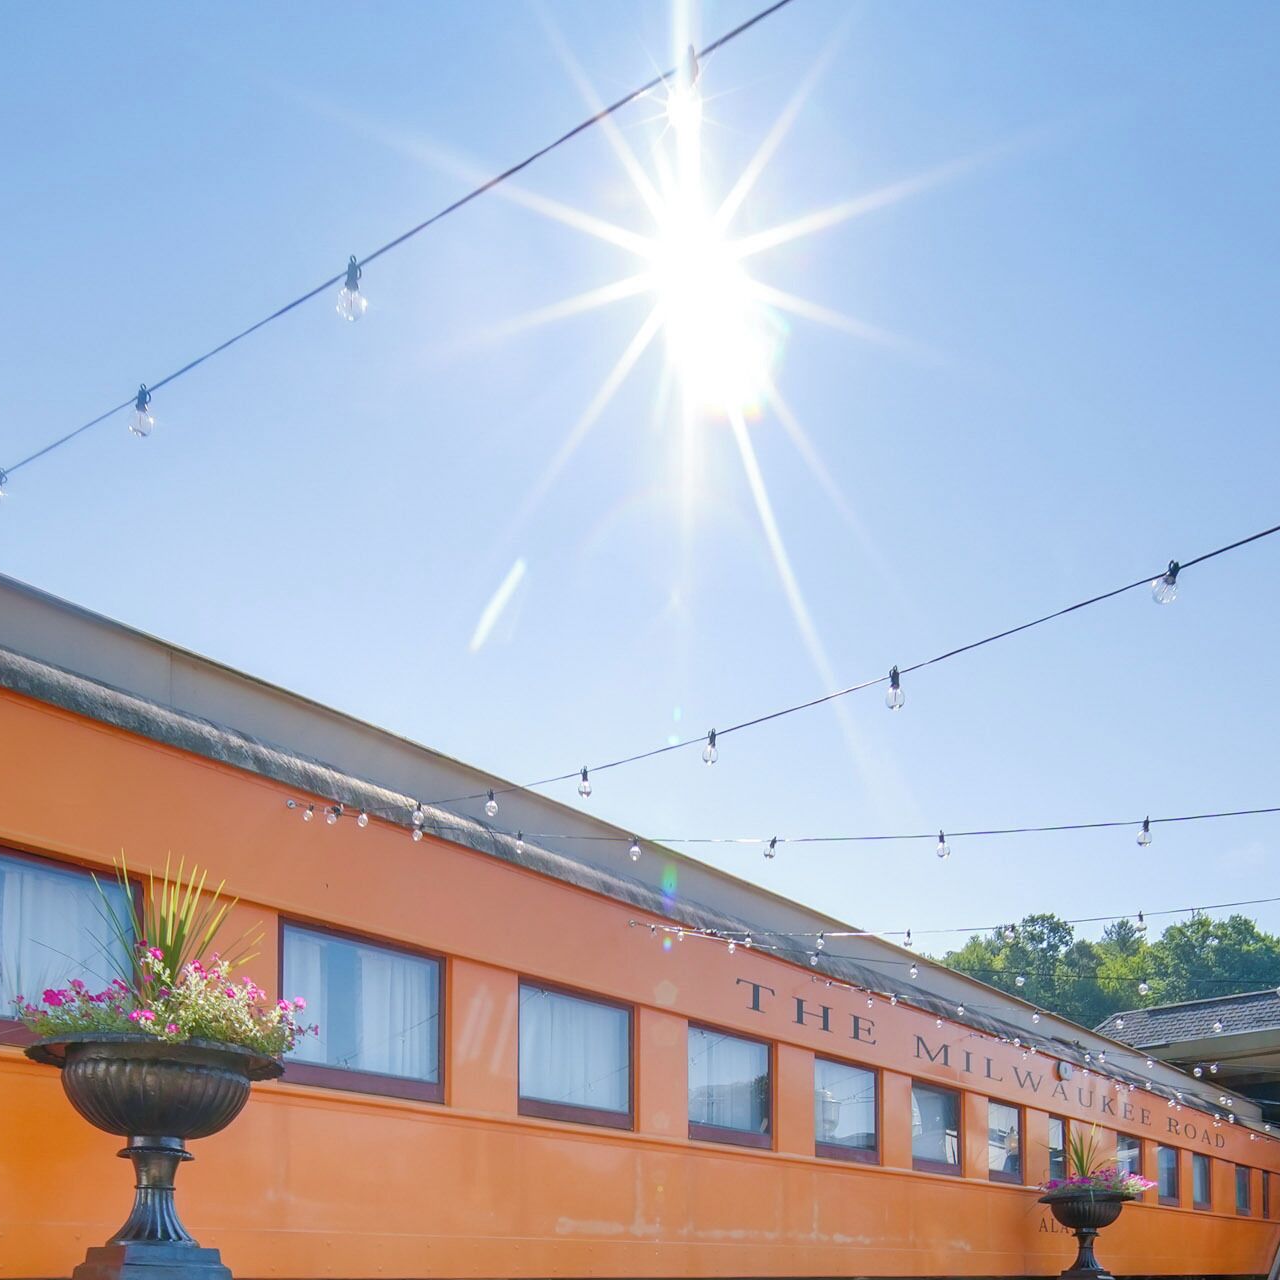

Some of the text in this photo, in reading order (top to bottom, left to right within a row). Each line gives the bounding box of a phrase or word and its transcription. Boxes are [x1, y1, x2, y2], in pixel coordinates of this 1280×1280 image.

[735, 977, 1226, 1149] THE MILWAUKEE ROAD
